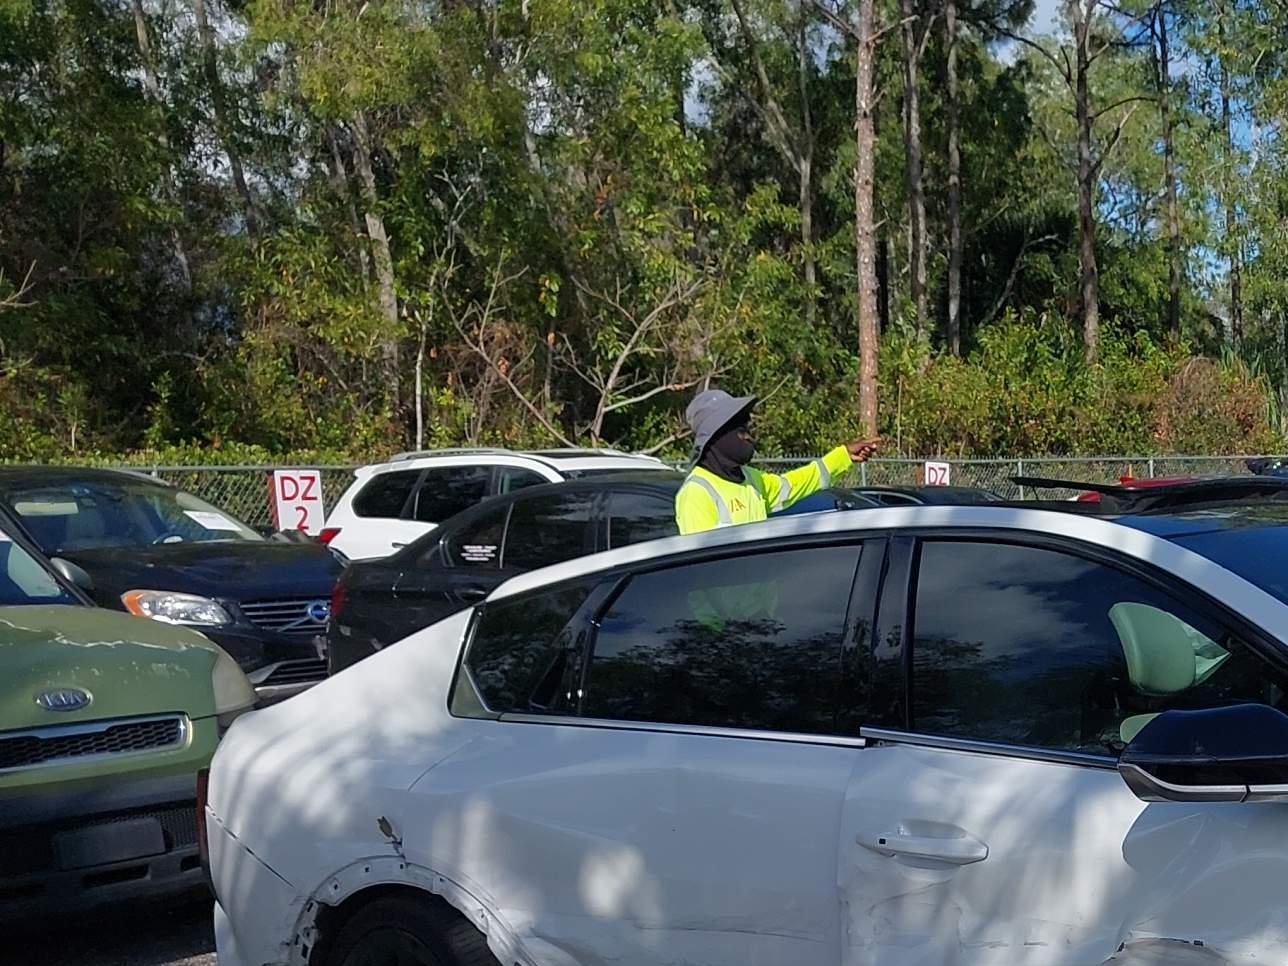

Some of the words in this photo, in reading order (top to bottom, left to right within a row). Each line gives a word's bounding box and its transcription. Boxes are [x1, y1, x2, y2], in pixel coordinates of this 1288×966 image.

[928, 466, 947, 485] DZ
[280, 476, 317, 500] DZ
[295, 505, 309, 530] 2
